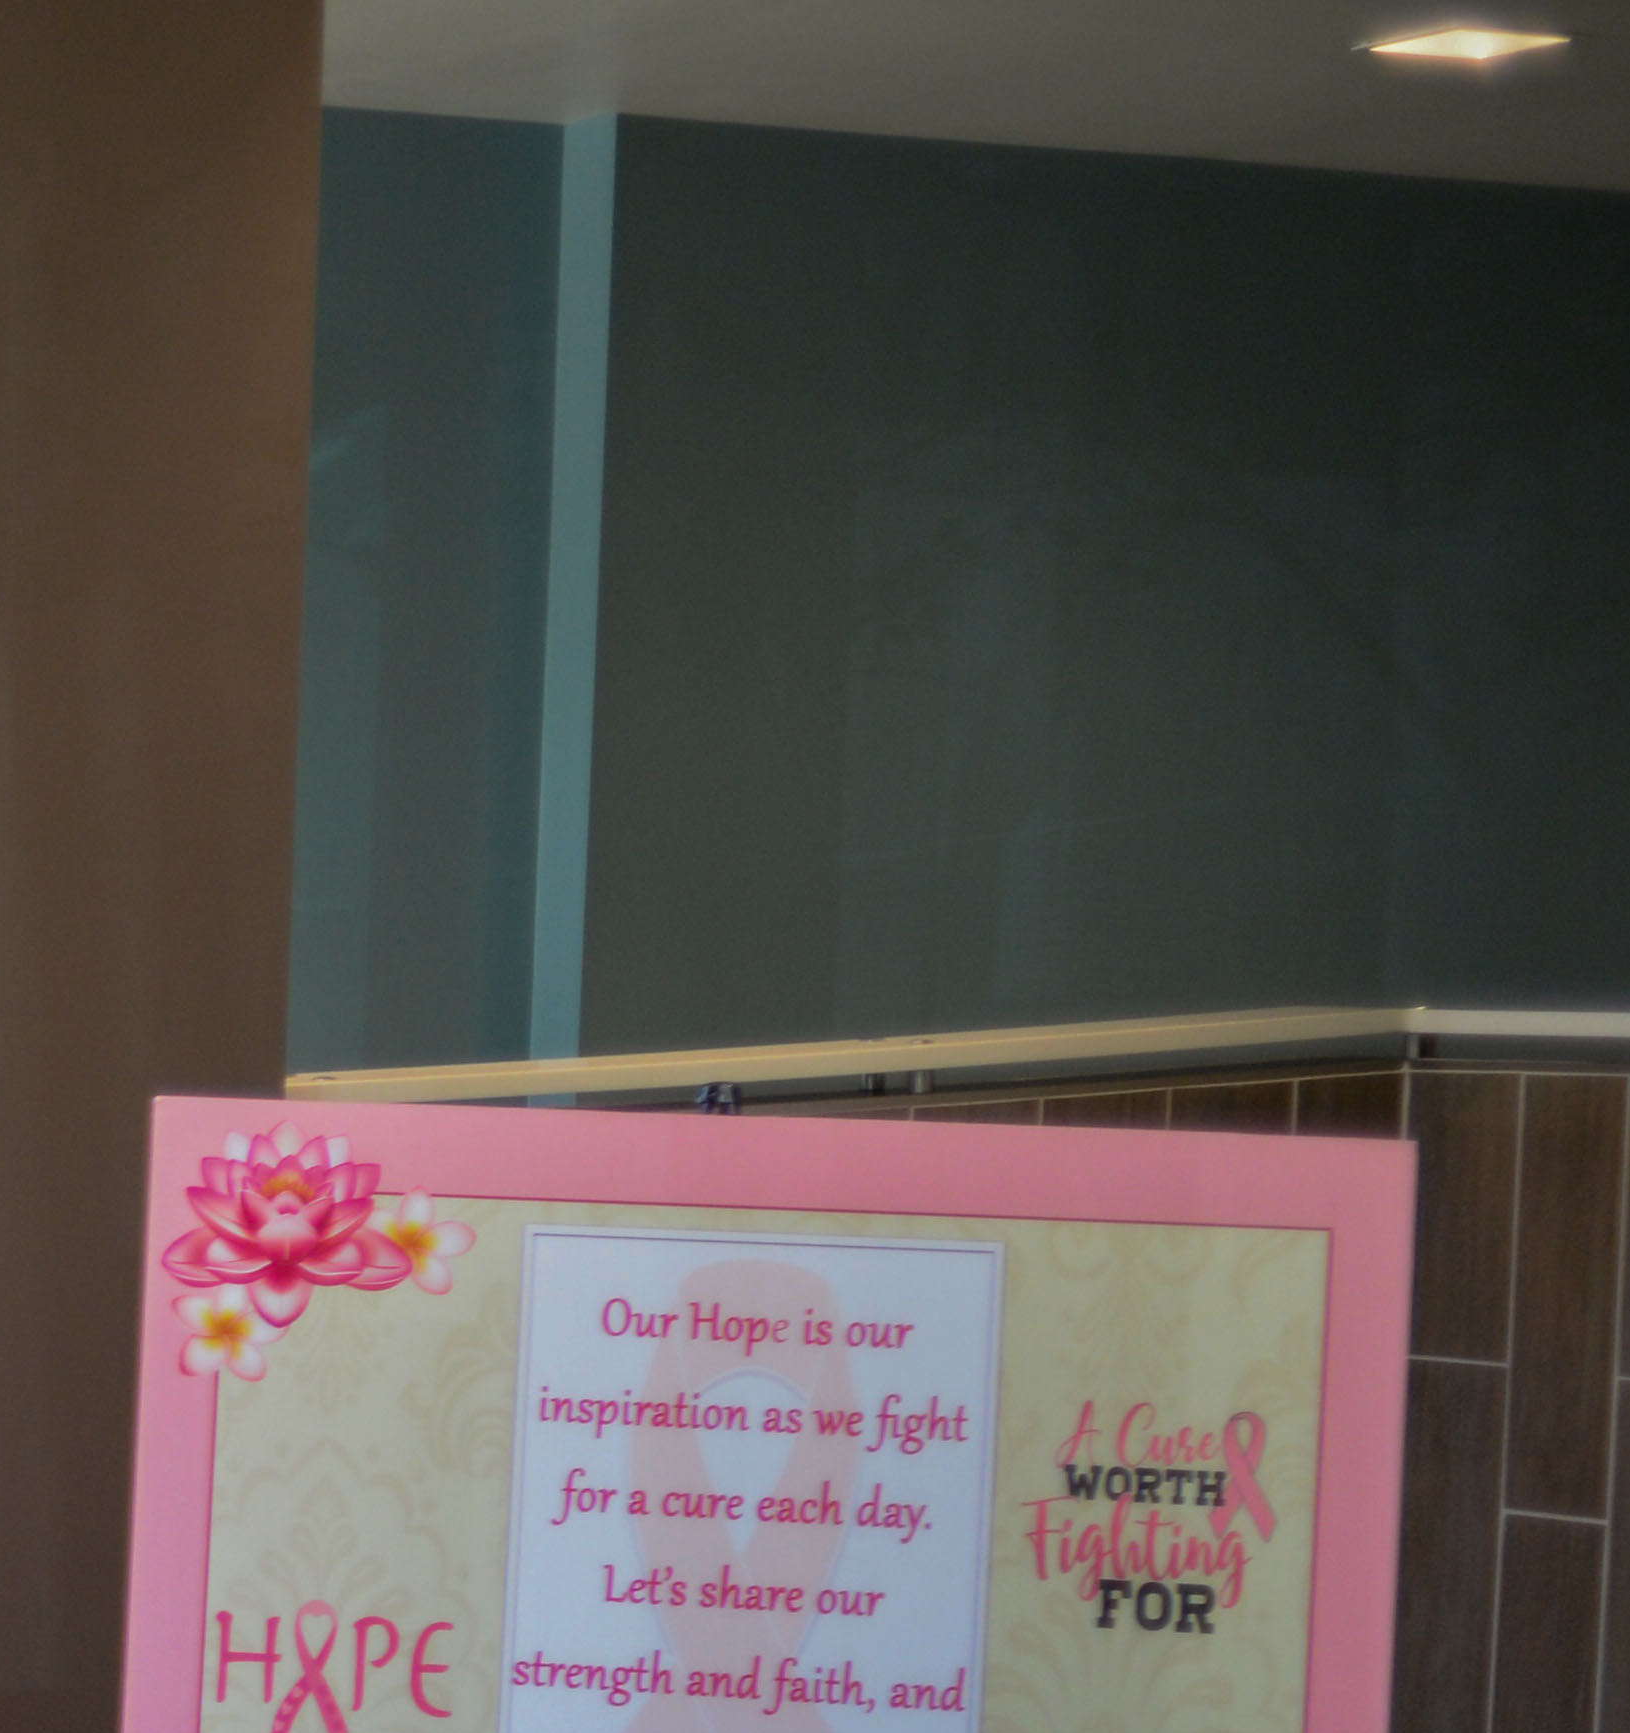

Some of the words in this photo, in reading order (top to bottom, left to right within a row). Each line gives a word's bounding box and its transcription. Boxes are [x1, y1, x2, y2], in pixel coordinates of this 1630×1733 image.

[601, 1297, 678, 1338] Our
[690, 1302, 789, 1357] Hope
[802, 1308, 832, 1346] is
[846, 1319, 914, 1349] our
[538, 1386, 749, 1438] inspiration
[762, 1405, 802, 1434] as
[813, 1410, 863, 1437] we
[865, 1394, 968, 1455] fight
[1054, 1400, 1102, 1468] A
[1116, 1401, 1225, 1468] Cure
[550, 1468, 618, 1525] for
[628, 1489, 648, 1516] a
[661, 1491, 744, 1520] cure
[757, 1481, 842, 1526] each
[855, 1483, 932, 1544] day.
[1064, 1464, 1227, 1507] WORTH
[1021, 1492, 1252, 1608] Fighting
[603, 1564, 687, 1607] Let's
[699, 1565, 804, 1613] share
[816, 1588, 885, 1617] our
[1096, 1579, 1216, 1634] FOR
[512, 1649, 673, 1707] strength
[687, 1655, 761, 1701] and
[762, 1658, 876, 1716] faith,
[889, 1667, 967, 1712] and
